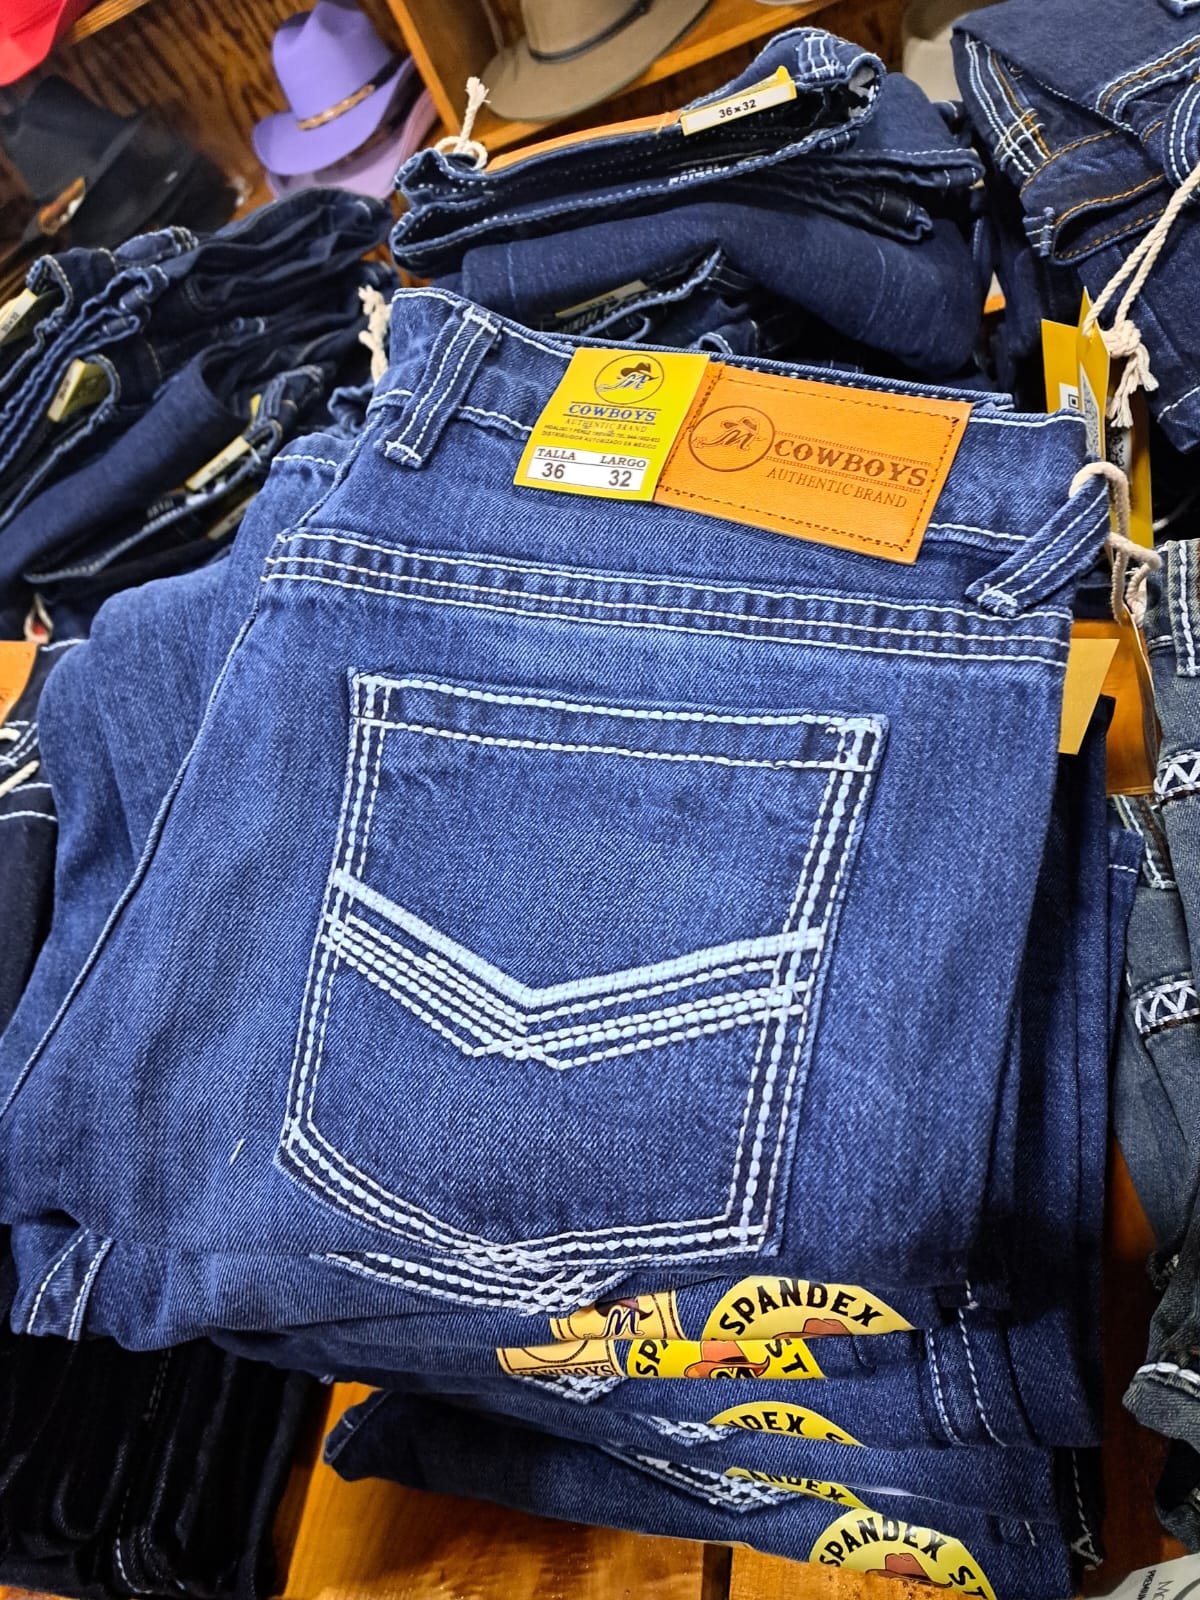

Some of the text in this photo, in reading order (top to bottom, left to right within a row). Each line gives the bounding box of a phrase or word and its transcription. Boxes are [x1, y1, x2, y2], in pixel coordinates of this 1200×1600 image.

[565, 418, 648, 433] AUTHENTIC BRAND
[568, 404, 657, 422] COWBOYS
[537, 448, 647, 468] TALLA LARGO
[774, 439, 929, 487] COWBOYS
[542, 463, 633, 487] 36 32
[766, 467, 907, 508] AUTHENTIC BRAND
[719, 1279, 883, 1336] SPANDEX
[819, 1516, 947, 1568] SPANDEX
